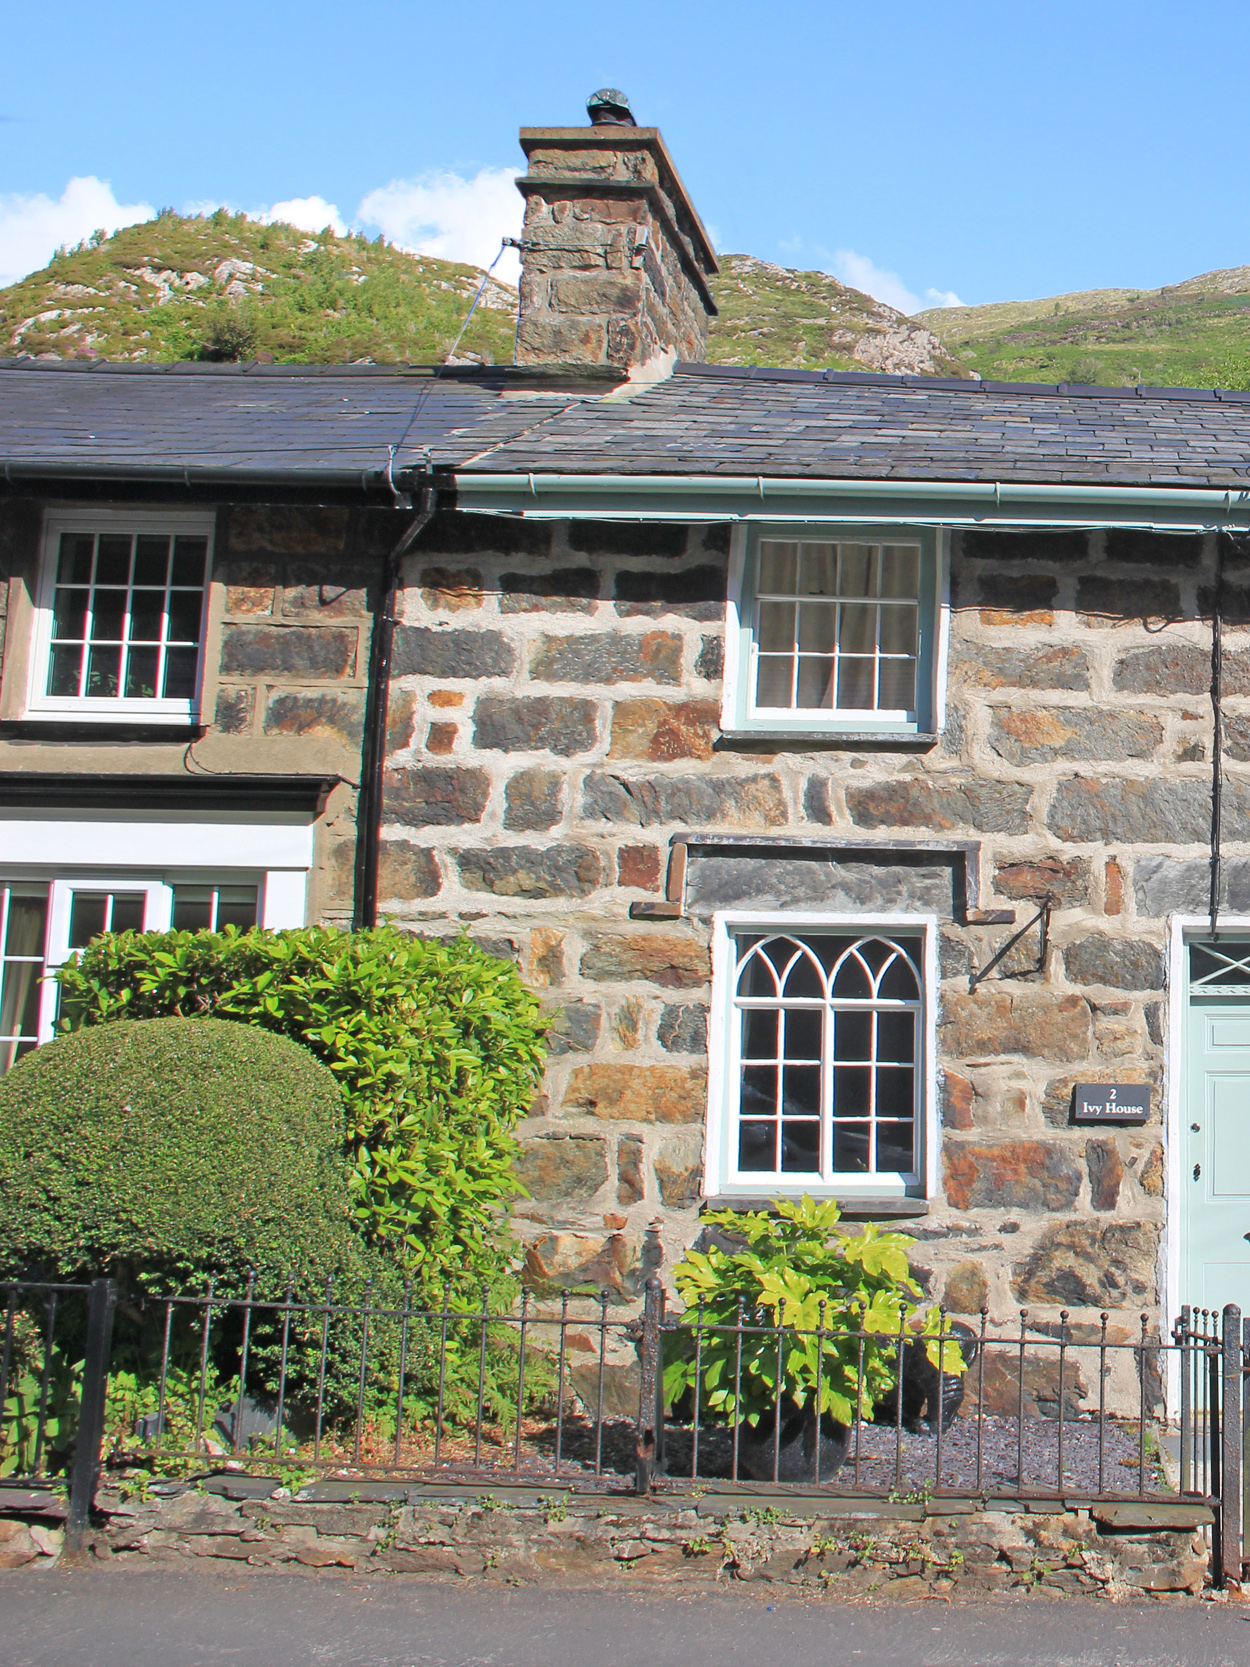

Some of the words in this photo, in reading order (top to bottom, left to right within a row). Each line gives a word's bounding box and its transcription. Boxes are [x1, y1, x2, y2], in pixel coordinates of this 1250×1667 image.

[1109, 1088, 1117, 1100] 2
[1083, 1101, 1103, 1116] Ivy
[1105, 1102, 1144, 1114] House
